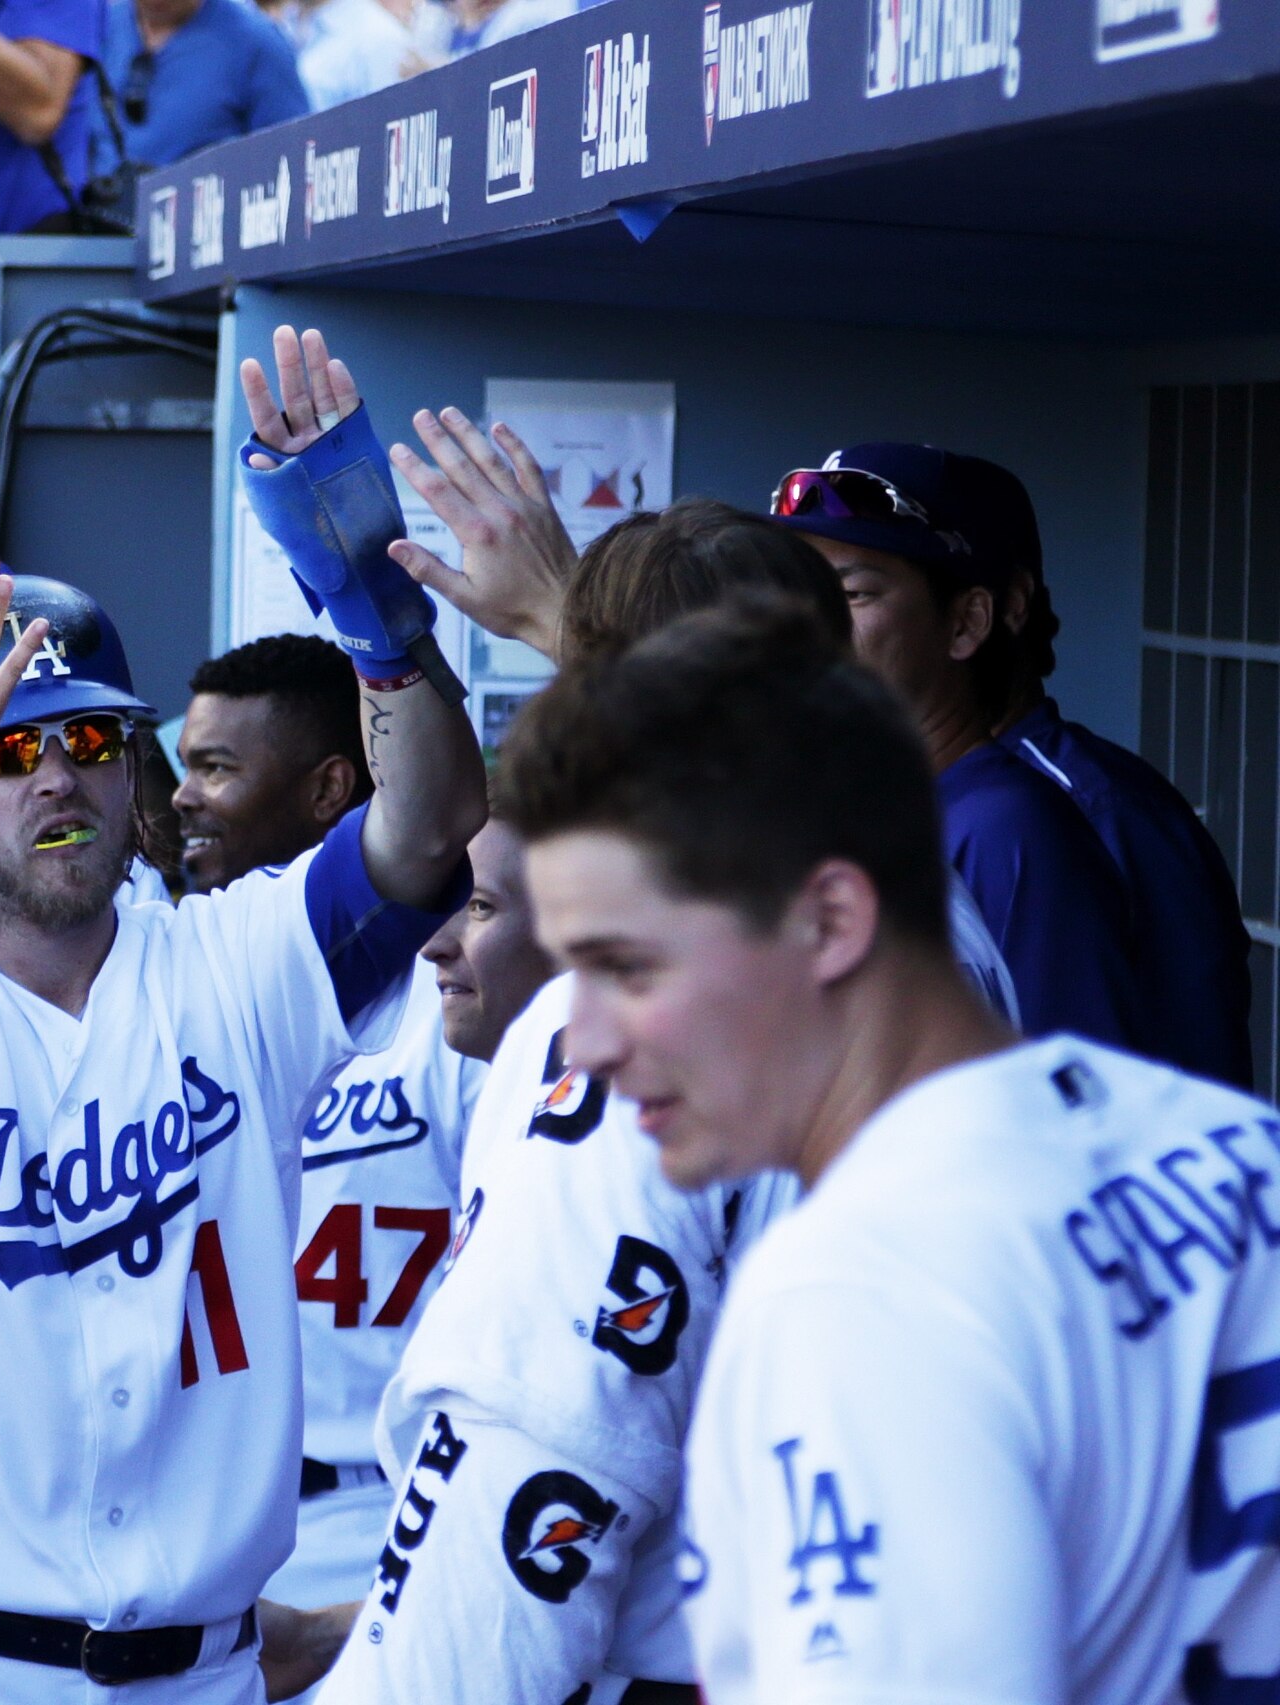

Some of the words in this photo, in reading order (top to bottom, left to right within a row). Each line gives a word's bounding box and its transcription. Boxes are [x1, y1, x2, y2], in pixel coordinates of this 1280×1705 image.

[597, 39, 621, 173] At
[618, 32, 650, 167] Bat
[745, 1, 813, 115] NETWORK
[293, 1203, 451, 1329] 47
[772, 1436, 881, 1609] LA
